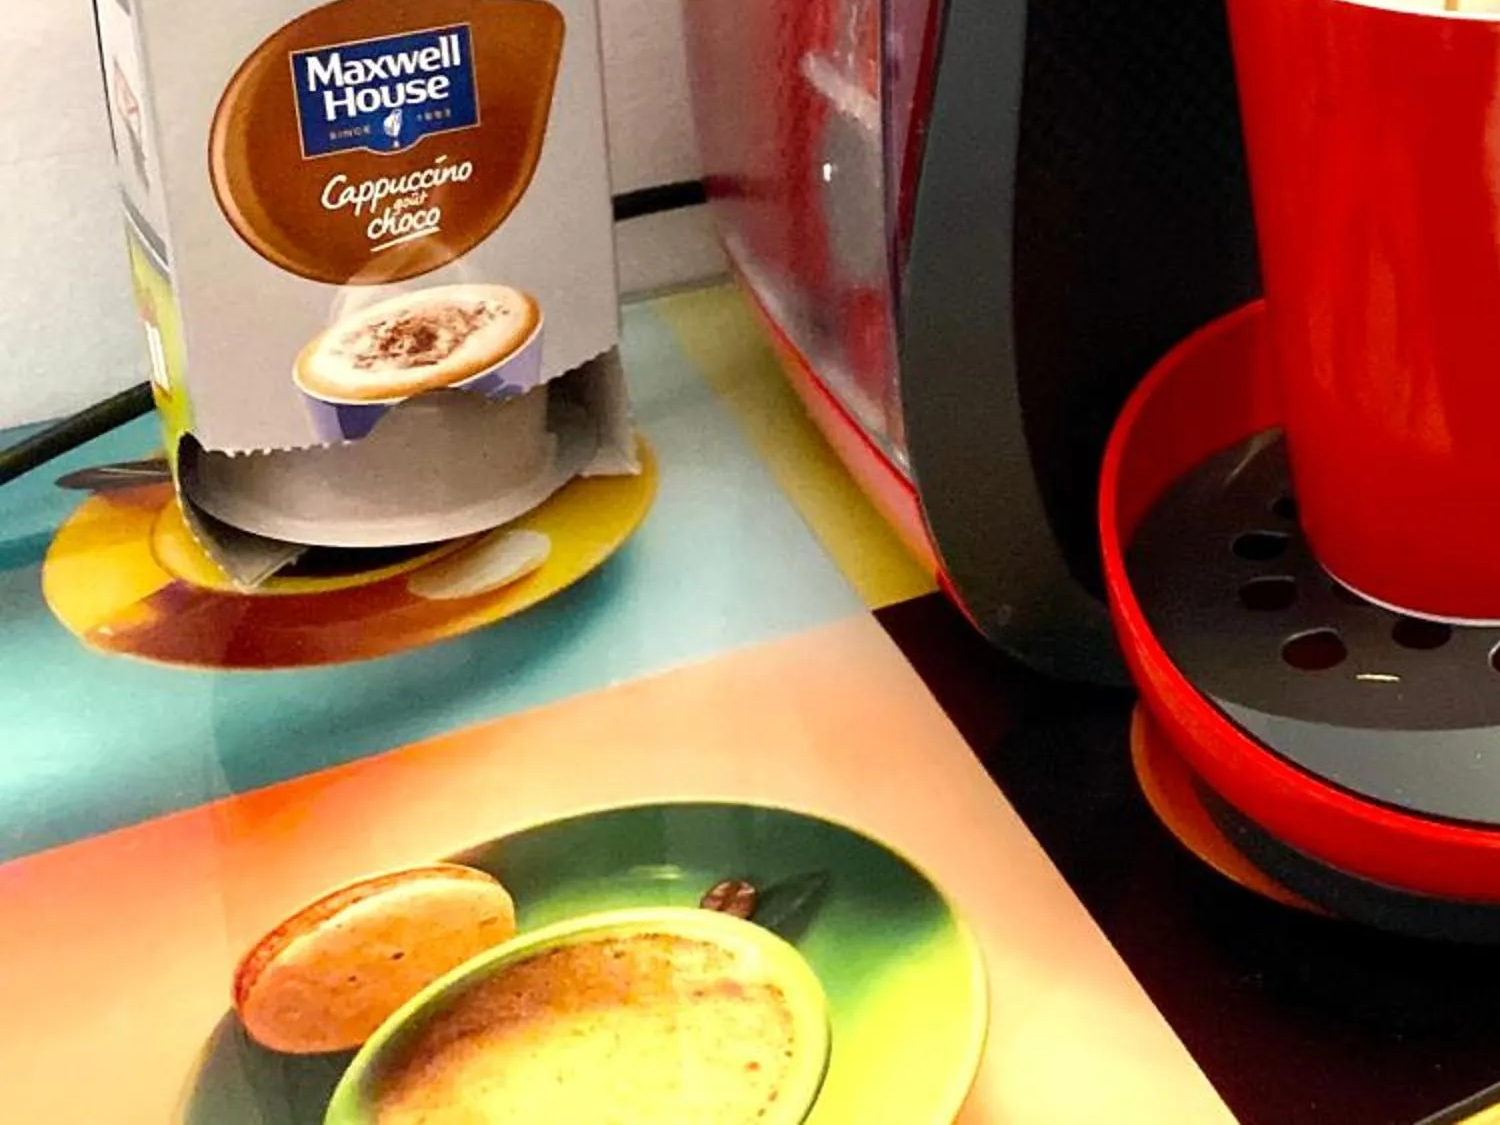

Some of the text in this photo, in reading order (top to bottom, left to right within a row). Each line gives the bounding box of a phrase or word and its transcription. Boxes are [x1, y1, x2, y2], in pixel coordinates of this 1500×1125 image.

[305, 34, 462, 92] Maxwell
[322, 75, 451, 122] House
[321, 155, 473, 216] Cappuccino
[367, 205, 441, 240] choco
